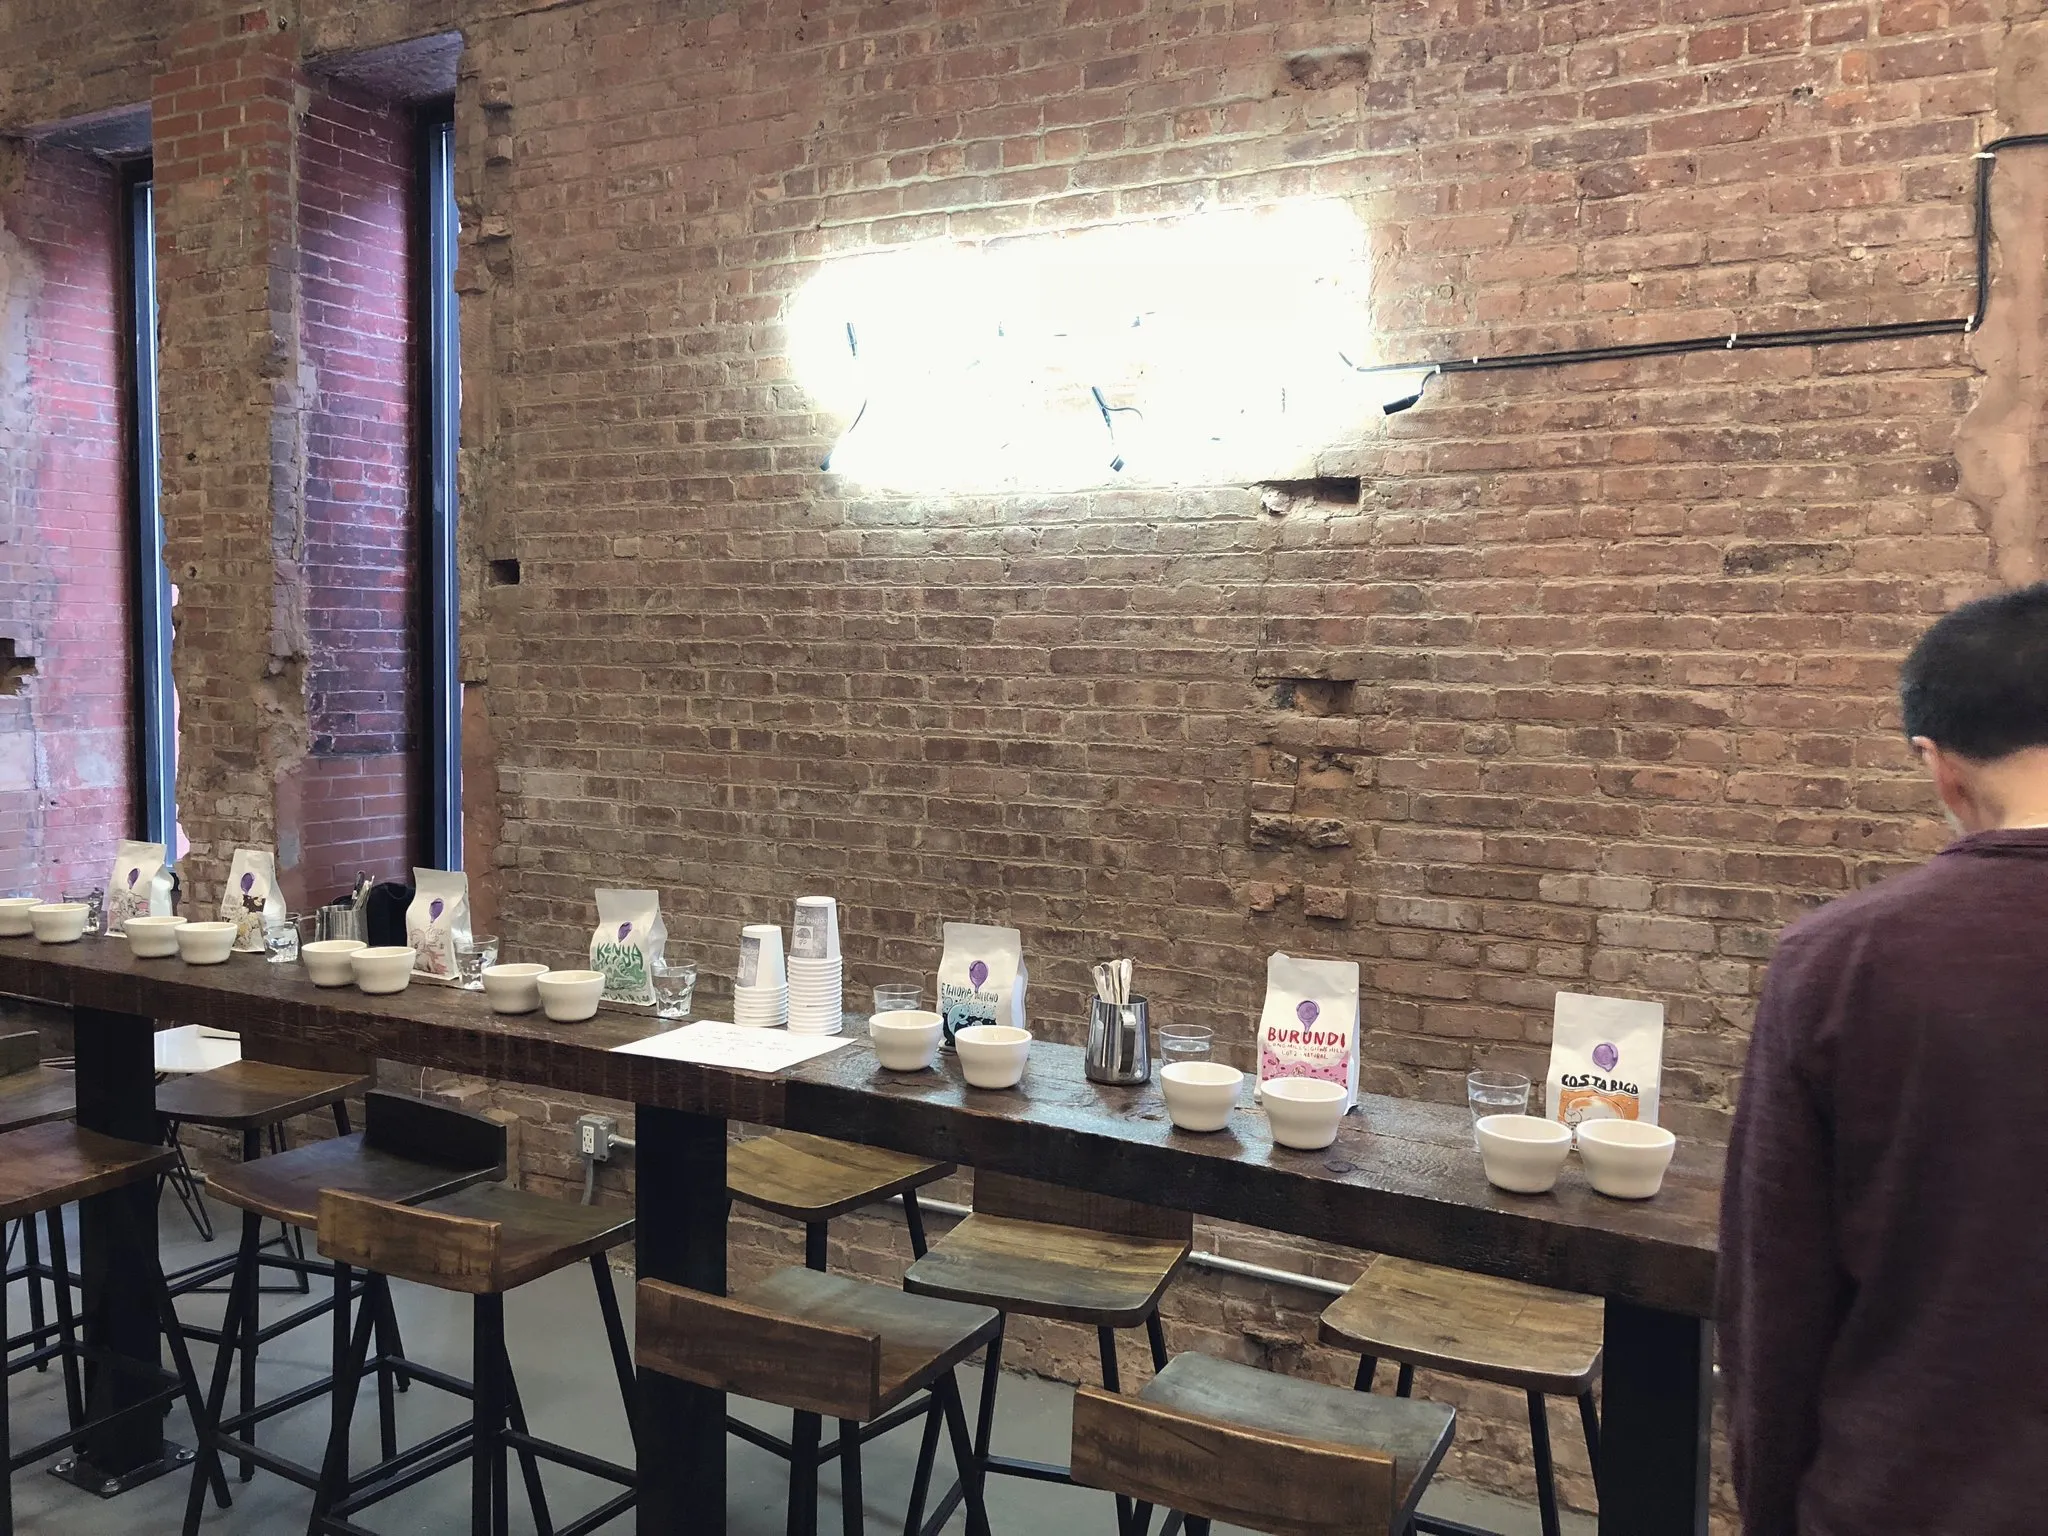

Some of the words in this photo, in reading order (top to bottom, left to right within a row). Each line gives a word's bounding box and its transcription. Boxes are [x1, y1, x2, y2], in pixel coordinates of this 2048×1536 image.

[596, 942, 644, 970] KENYA
[1267, 1027, 1346, 1048] BURUNDI
[1561, 1074, 1607, 1091] COSTA
